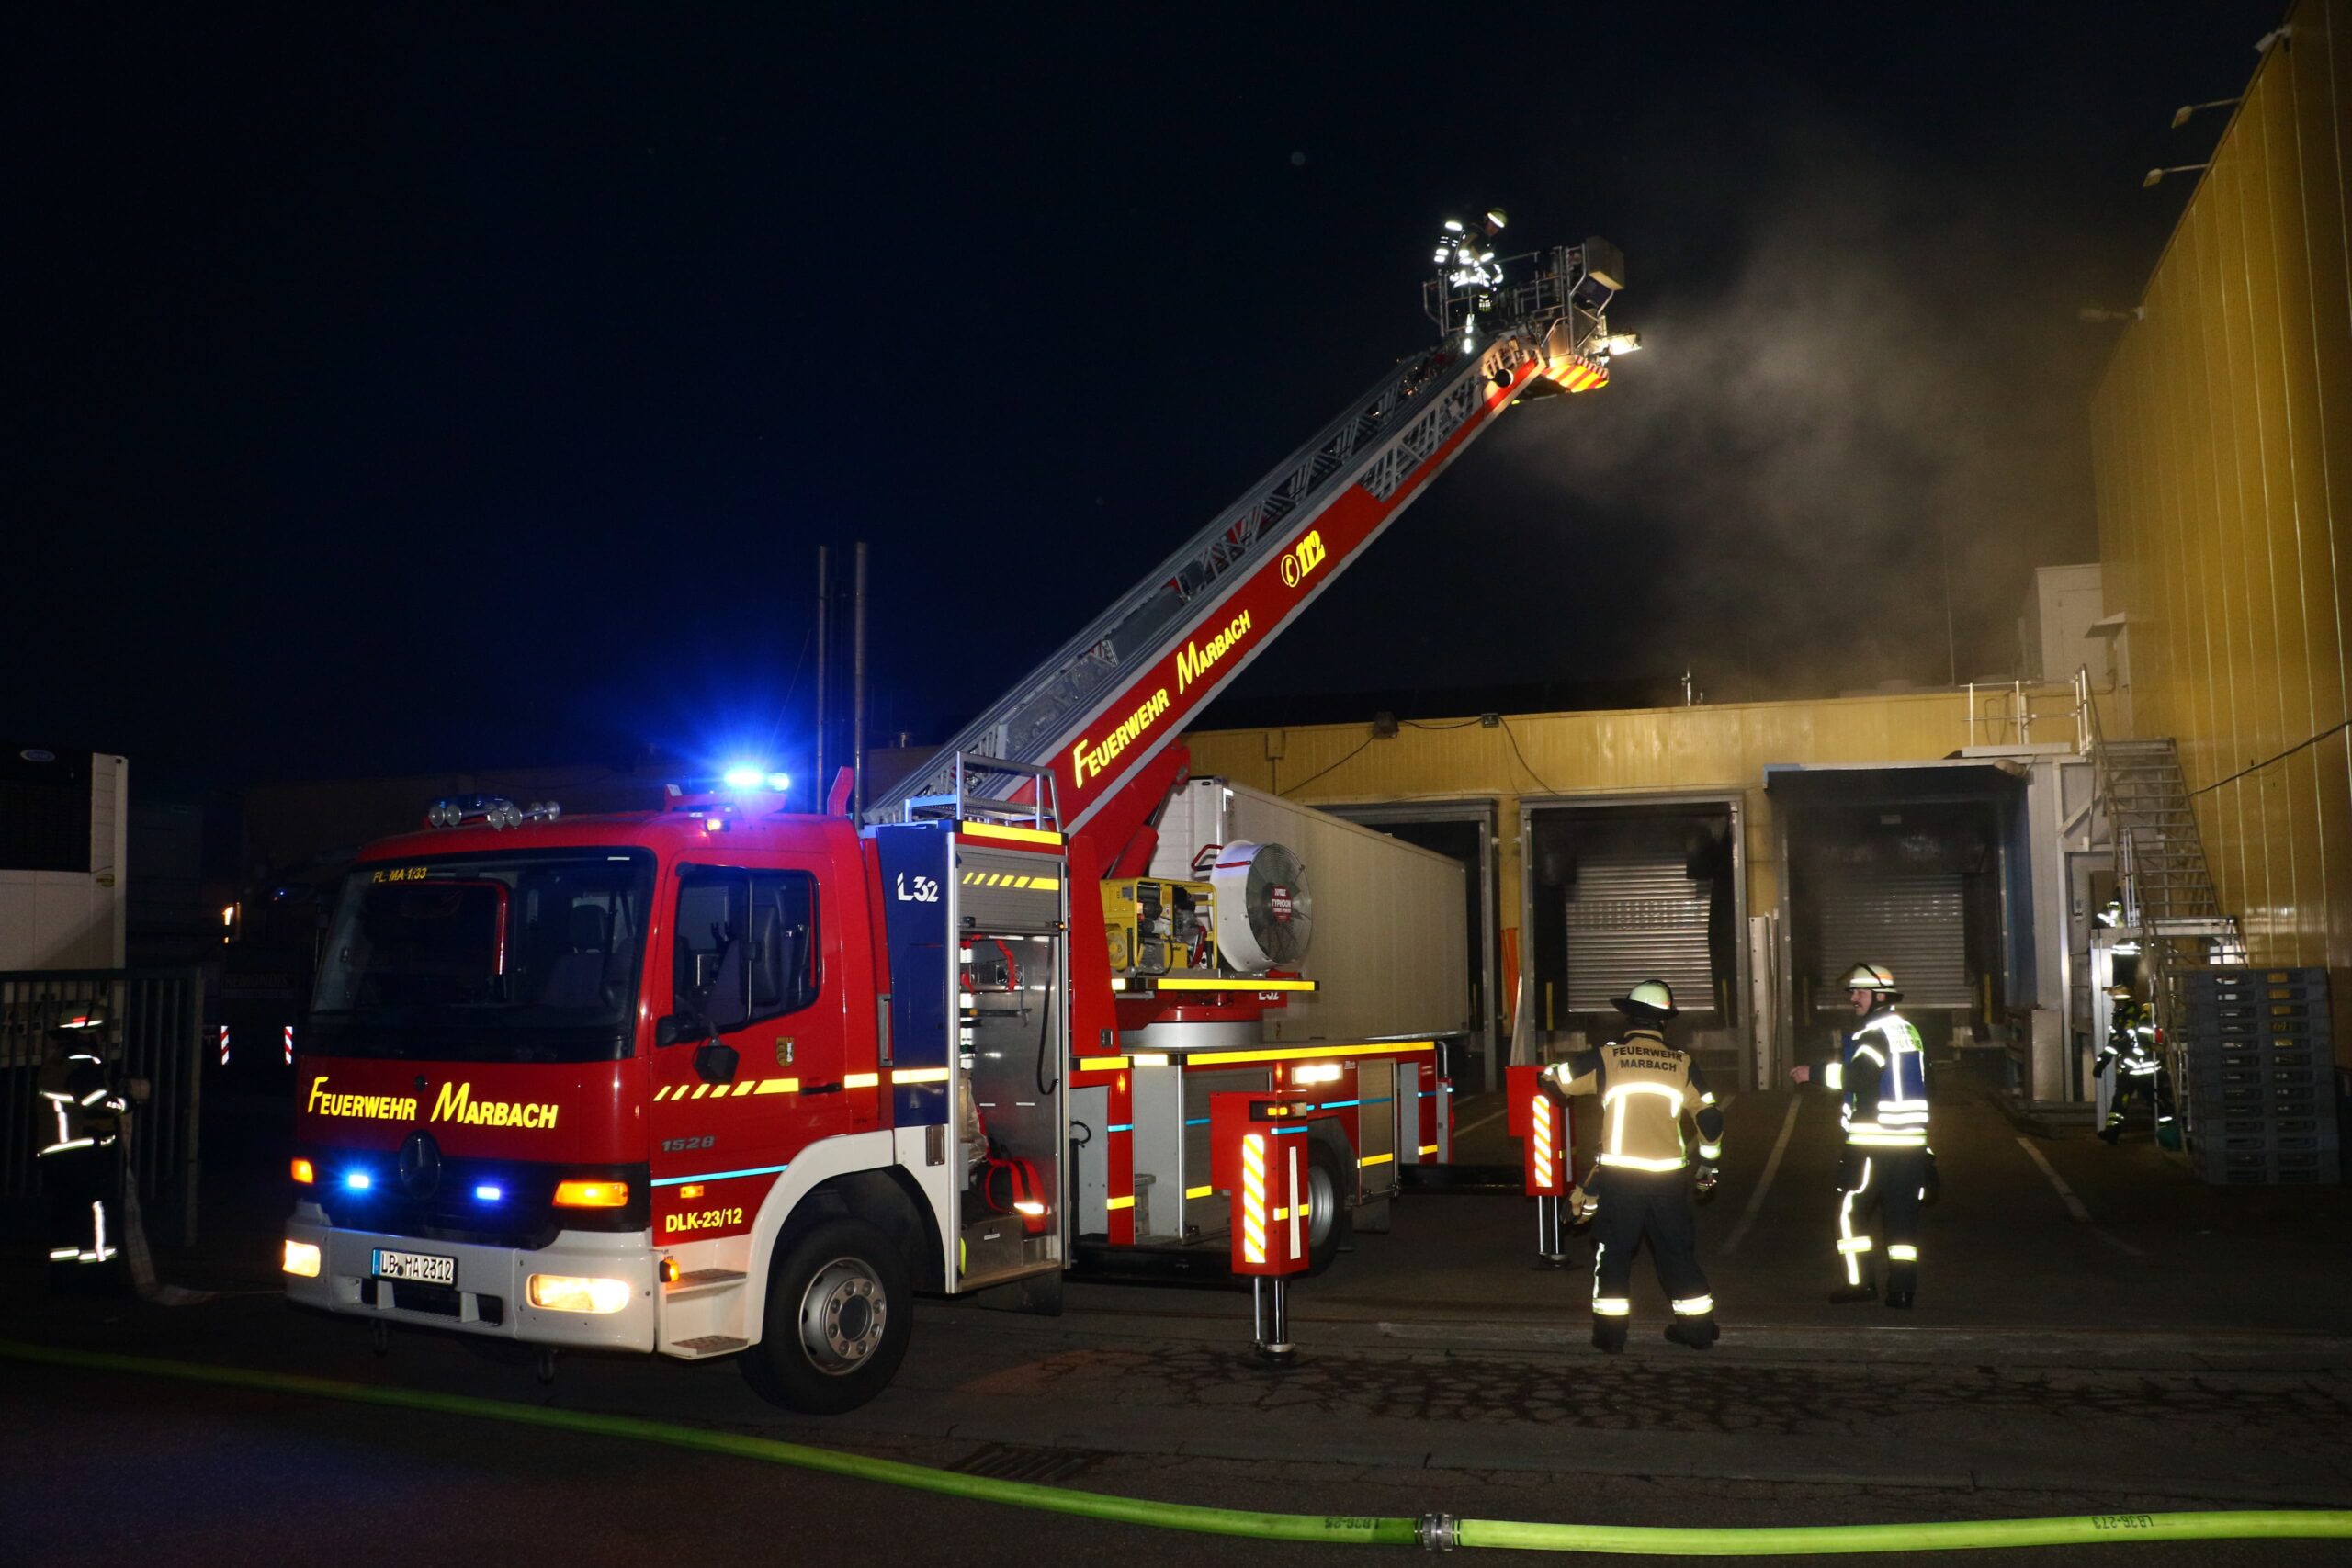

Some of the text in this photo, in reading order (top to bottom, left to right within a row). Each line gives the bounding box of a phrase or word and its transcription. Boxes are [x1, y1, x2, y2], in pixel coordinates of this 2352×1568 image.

[1296, 530, 1326, 577] 112
[1072, 610, 1252, 789] FEUERWEHR MARBACH
[389, 869, 404, 882] MA
[407, 867, 427, 880] 1/33
[897, 872, 940, 902] L32
[1612, 1046, 1683, 1062] FEUERWEHR
[1620, 1059, 1677, 1072] MARBACH
[307, 1076, 559, 1129] FEUERWEHR MARBACH
[662, 1135, 715, 1152] 1528
[665, 1207, 743, 1233] DLK-23/12
[423, 1258, 452, 1280] 2312
